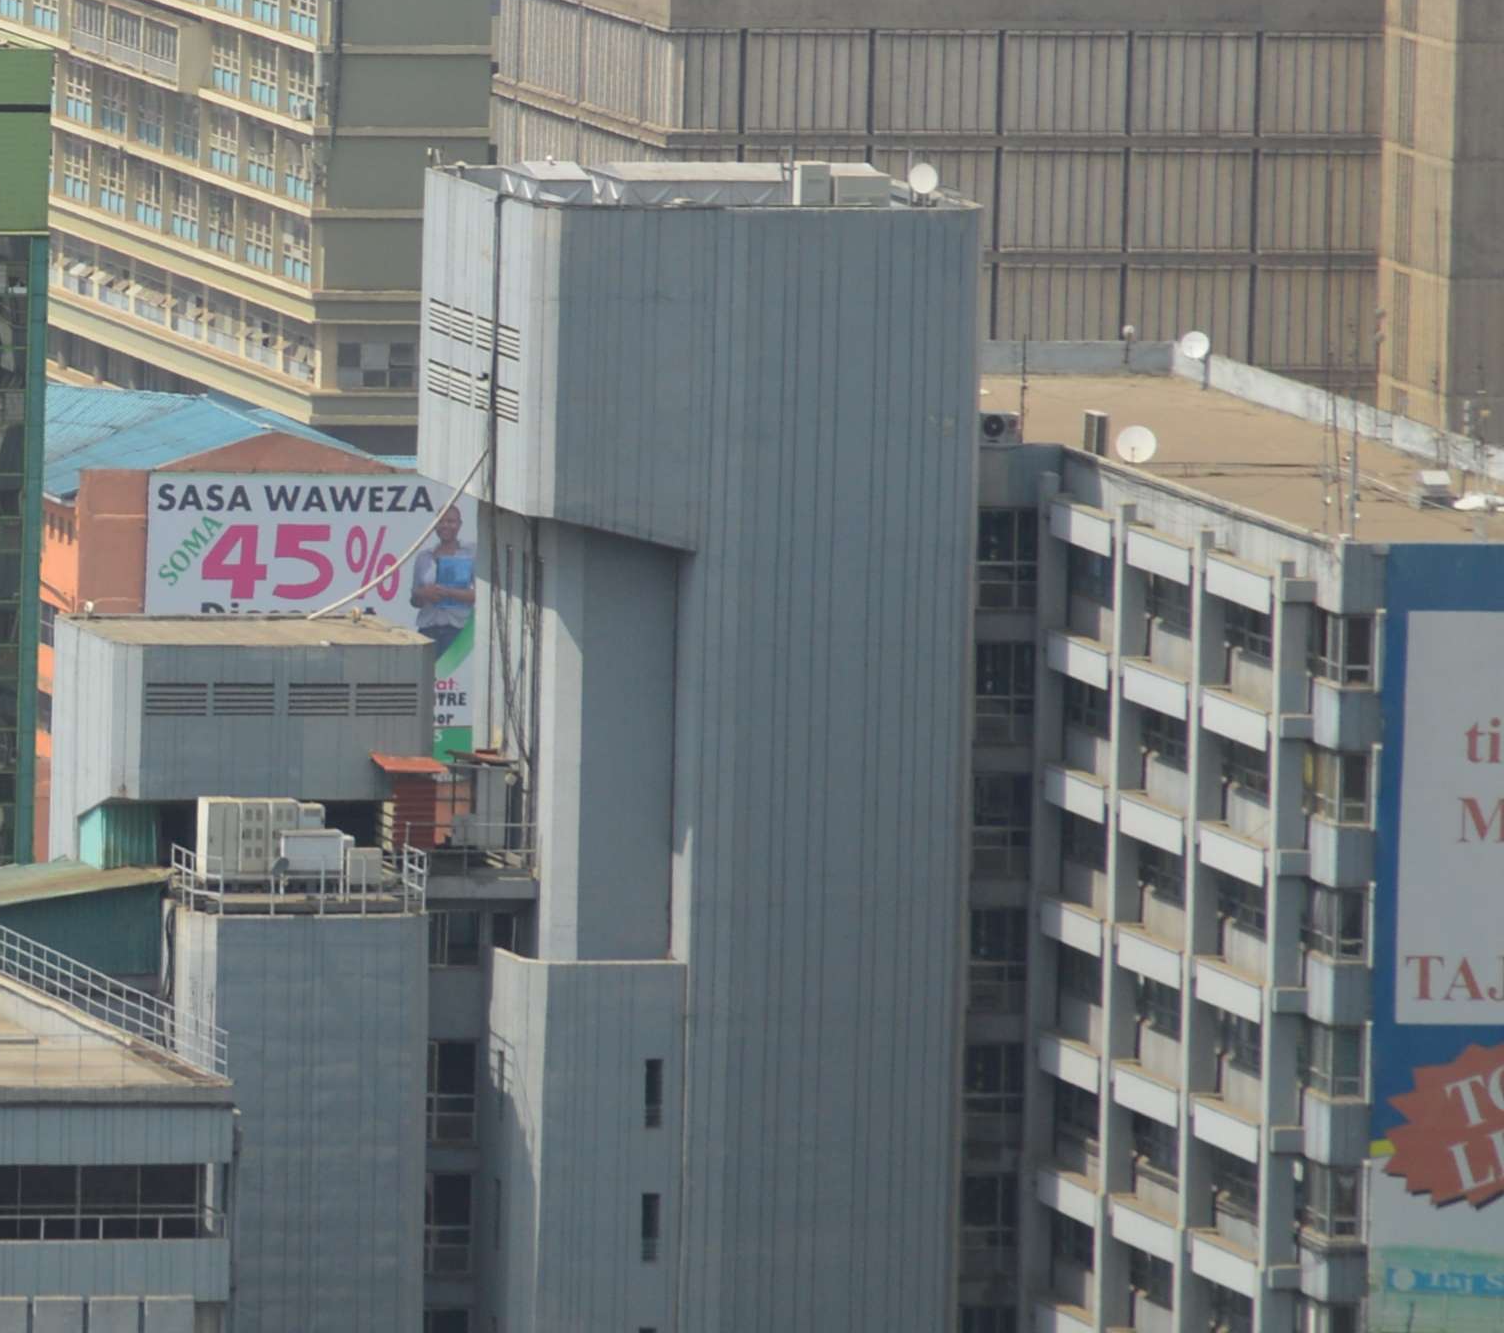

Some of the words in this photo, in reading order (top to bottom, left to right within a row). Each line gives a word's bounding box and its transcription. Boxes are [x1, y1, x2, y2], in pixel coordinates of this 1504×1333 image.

[157, 483, 253, 512] SASA
[263, 484, 435, 513] WAWEZA
[158, 514, 224, 587] SOMA
